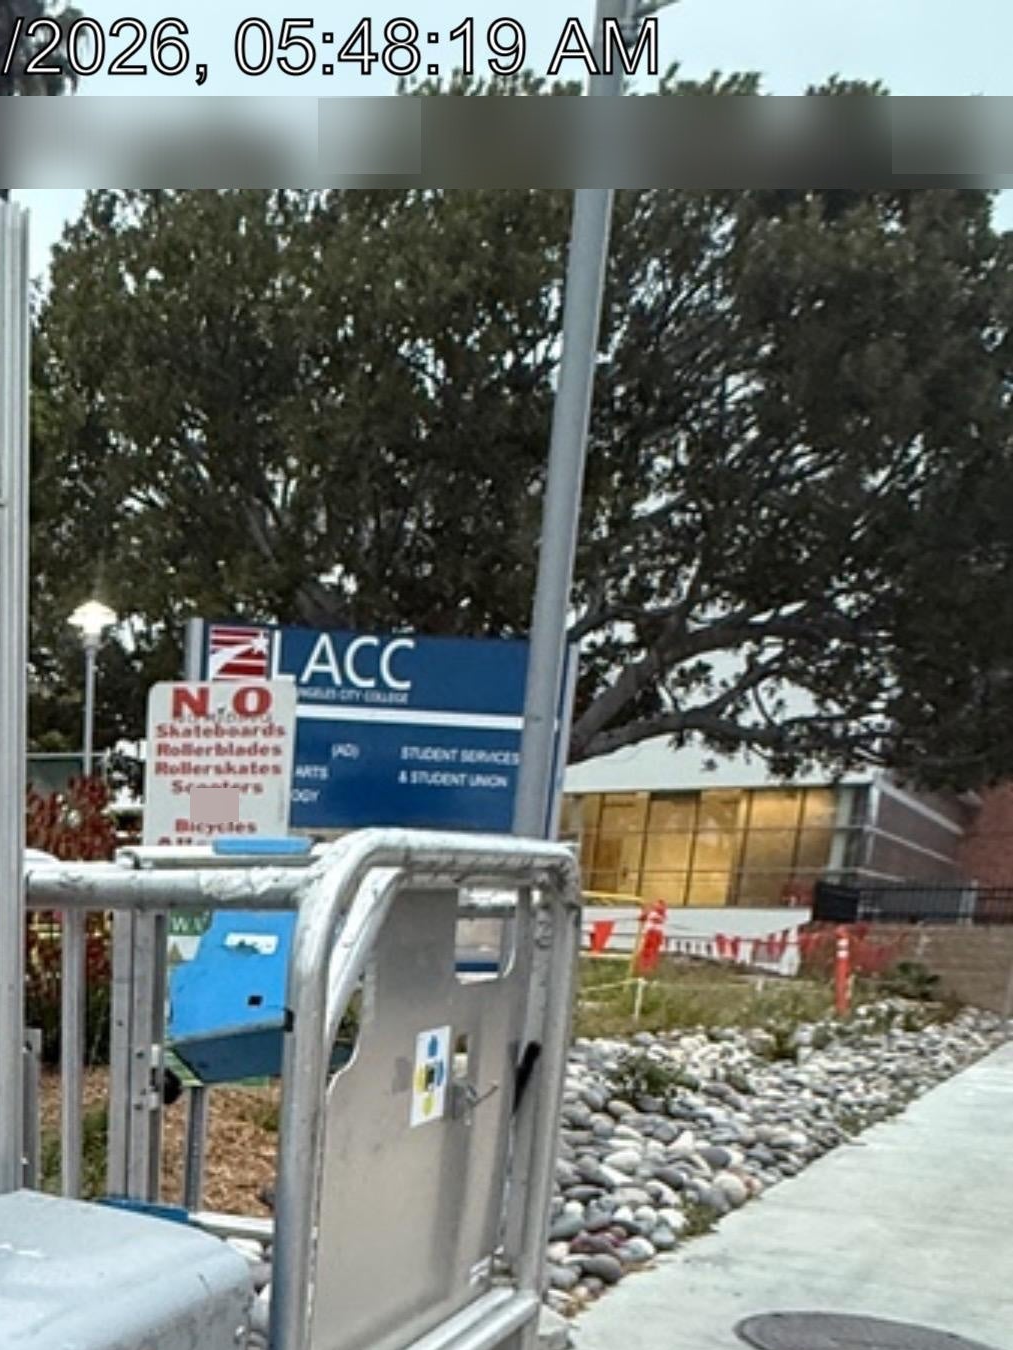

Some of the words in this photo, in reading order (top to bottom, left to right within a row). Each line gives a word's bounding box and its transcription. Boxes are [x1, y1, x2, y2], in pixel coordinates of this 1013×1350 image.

[272, 629, 415, 690] LACC
[172, 686, 272, 718] NO
[156, 723, 286, 738] Skateboards
[157, 743, 283, 756] Rollerblades
[400, 746, 457, 762] STUDENT
[461, 749, 520, 765] SERVICES
[155, 761, 283, 775] Rollerskates
[410, 771, 466, 787] STUDENT
[469, 774, 508, 788] UNION
